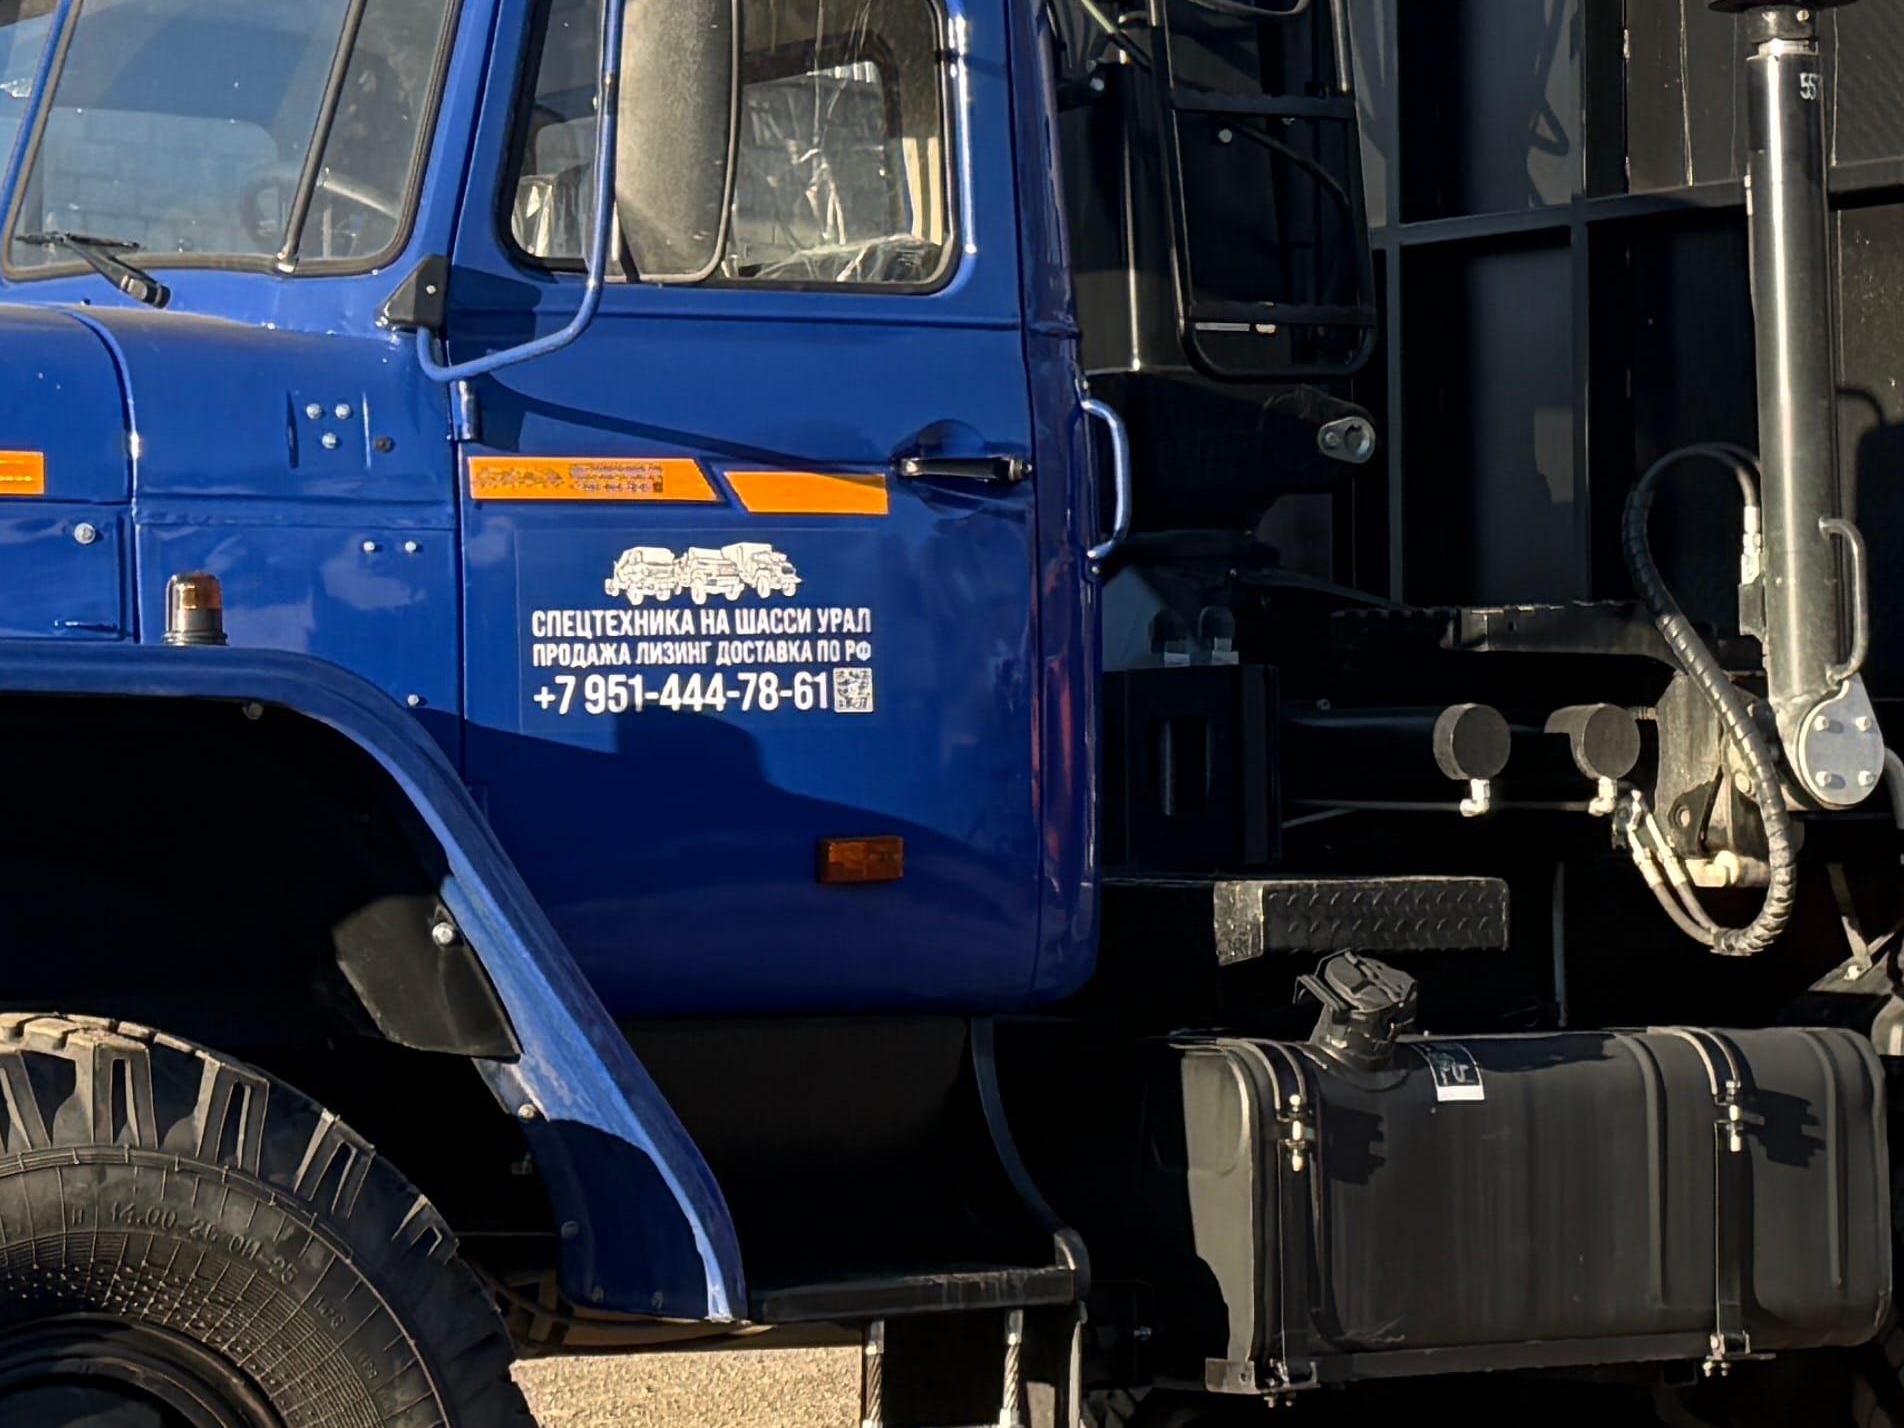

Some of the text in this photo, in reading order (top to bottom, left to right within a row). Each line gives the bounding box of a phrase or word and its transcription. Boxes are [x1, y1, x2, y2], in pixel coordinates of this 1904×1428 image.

[531, 607, 872, 639] СПЕЦТЕХНИКА НА ШАССИ УРАЛ
[532, 640, 872, 669] ПРОДАЖА ЛИЗИНГ ДОСТАВКА ПО РФ
[533, 671, 829, 715] +7 951-444-78-61
